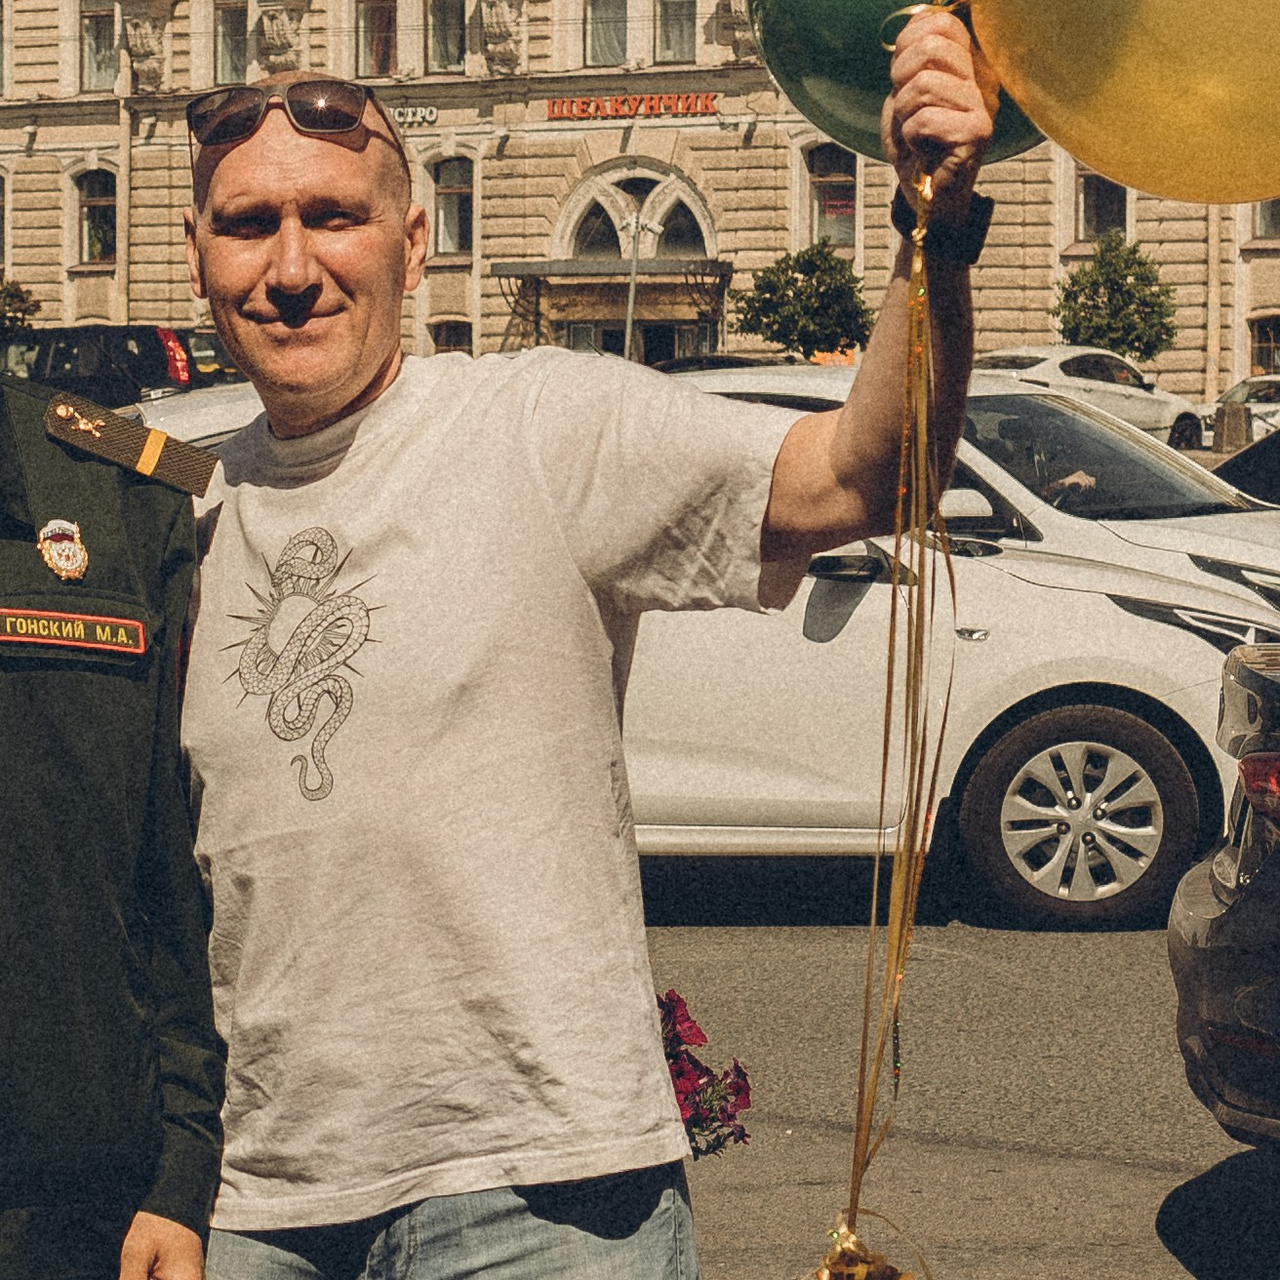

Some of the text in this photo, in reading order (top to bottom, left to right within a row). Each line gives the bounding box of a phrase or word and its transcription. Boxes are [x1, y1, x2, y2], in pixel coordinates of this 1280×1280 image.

[547, 92, 718, 119] ЩЕЛКУНЧИК
[5, 617, 134, 645] ГОНСКИЙ М.А.
